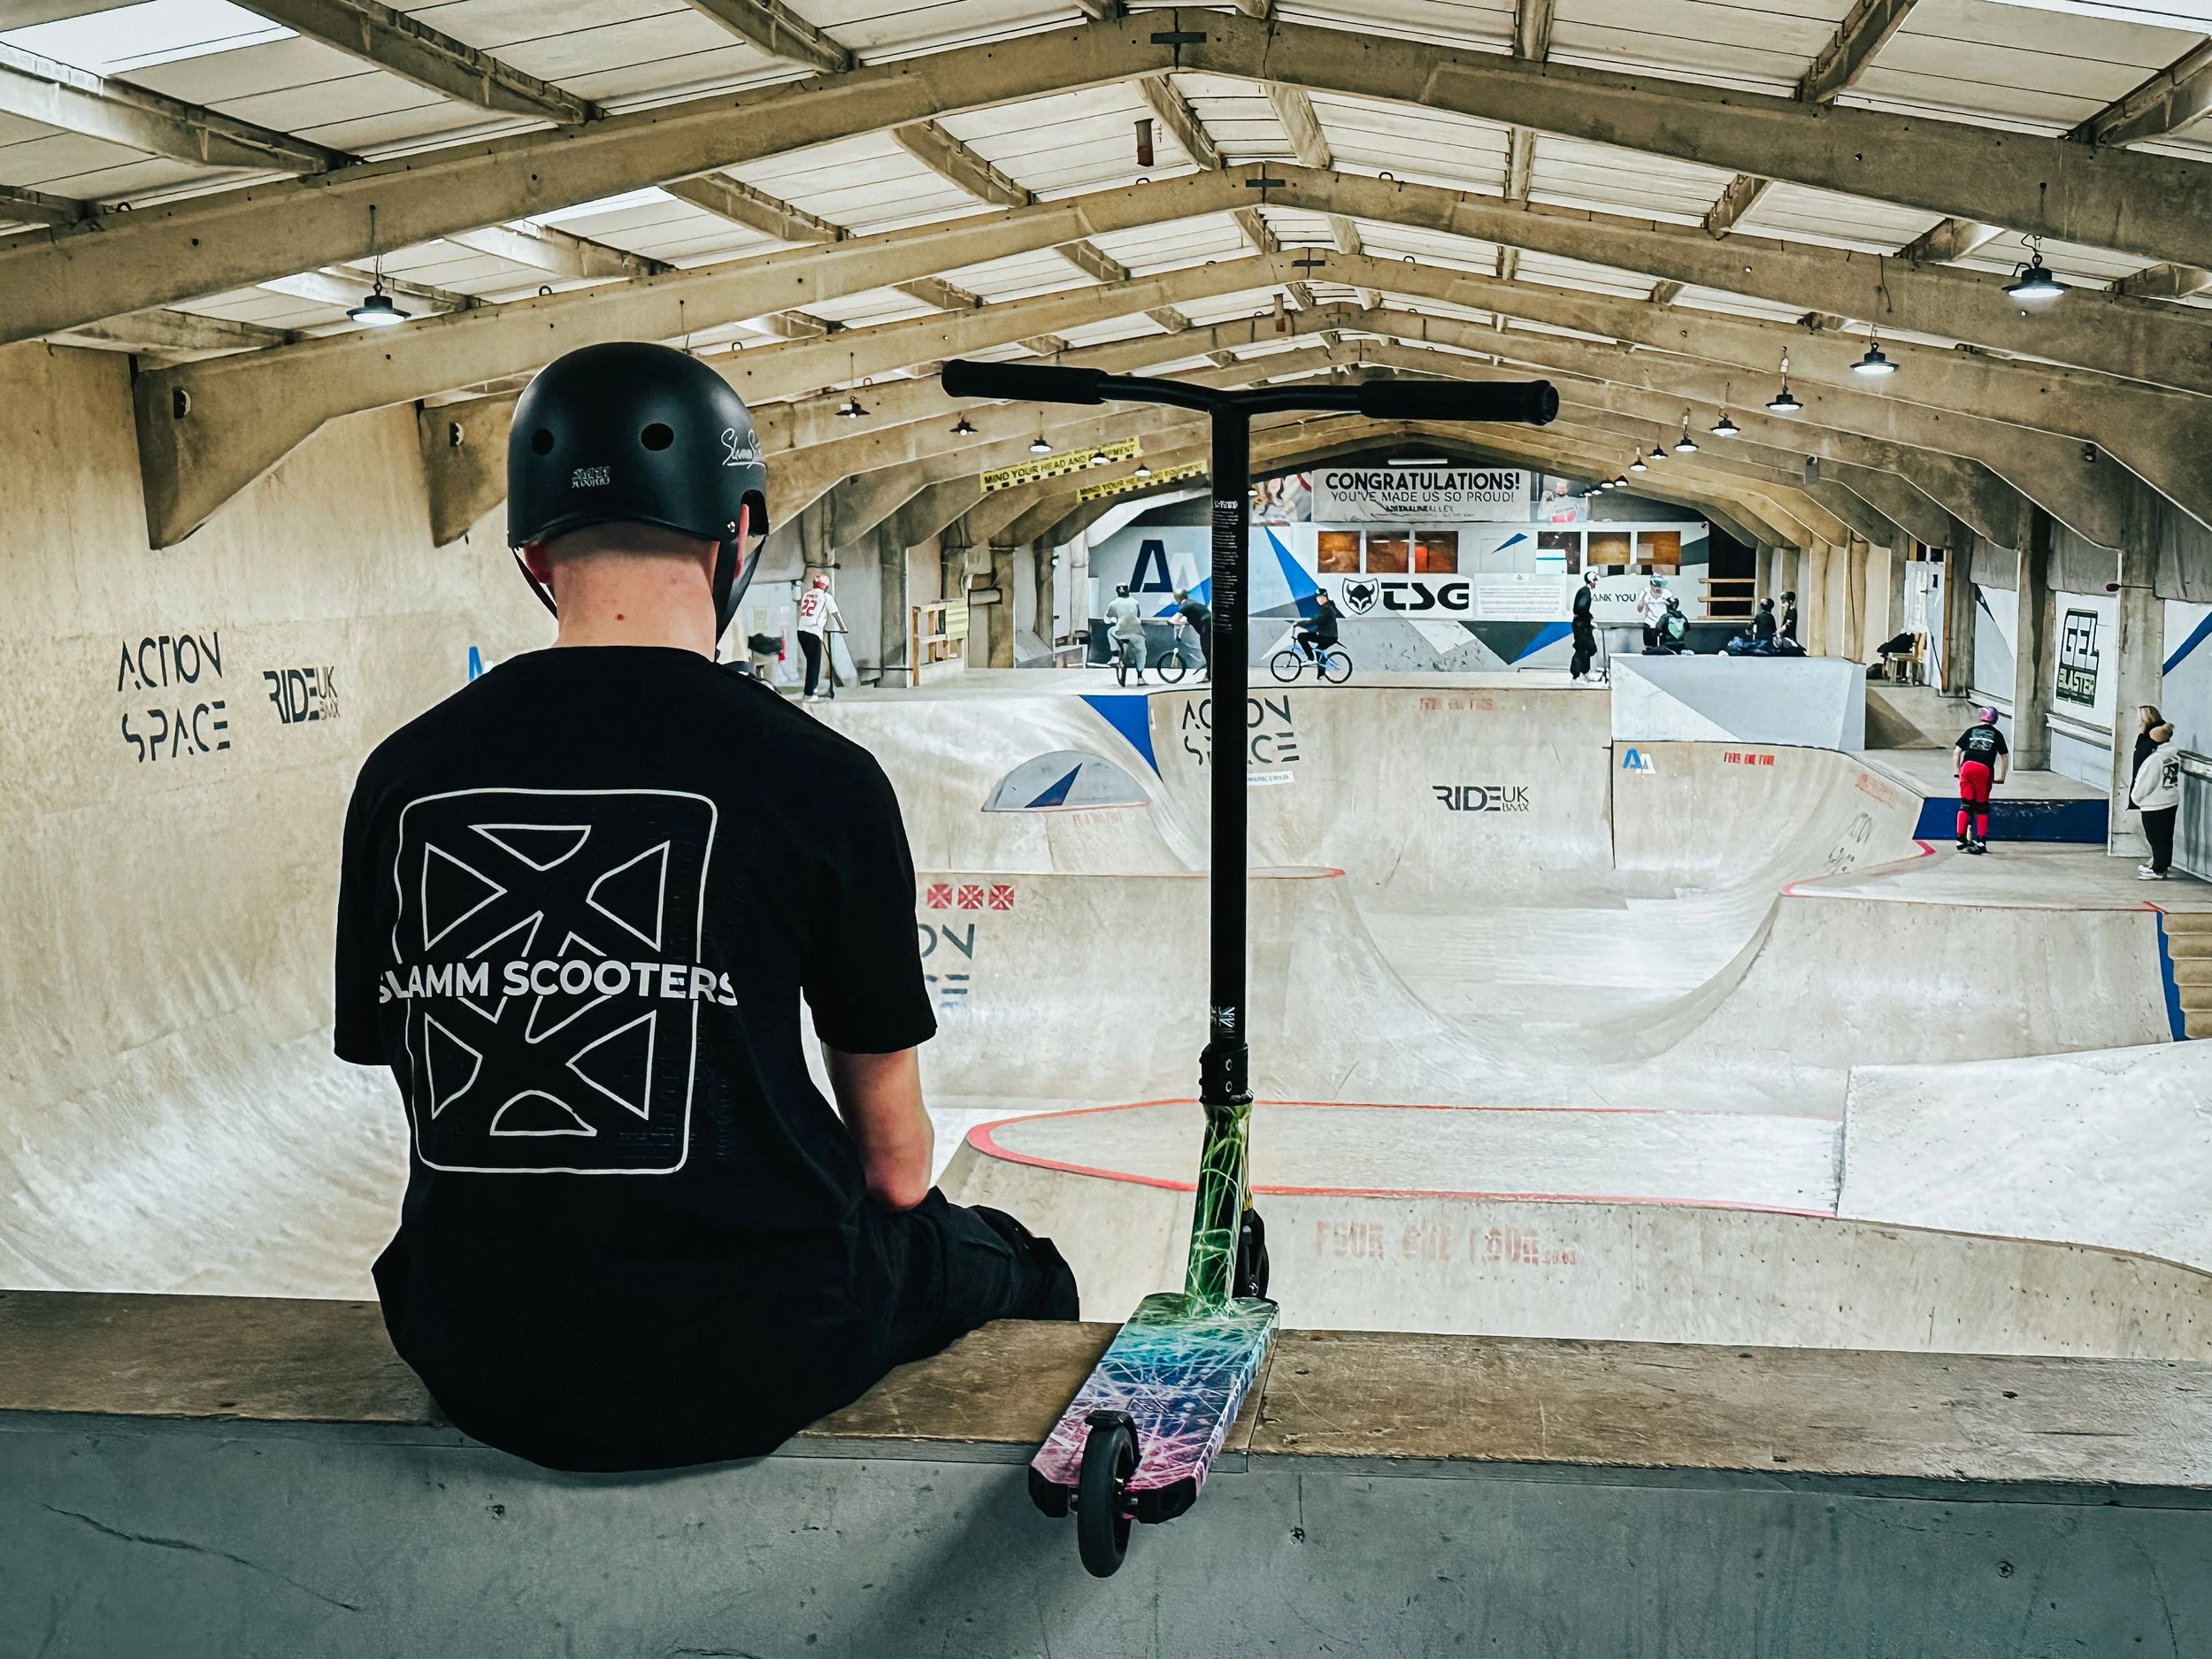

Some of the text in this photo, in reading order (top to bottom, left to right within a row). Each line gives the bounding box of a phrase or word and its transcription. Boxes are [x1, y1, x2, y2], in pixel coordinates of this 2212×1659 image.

[984, 472, 1010, 485] MIND
[1011, 465, 1038, 479] YOUR
[1041, 458, 1065, 471] HEAD
[1068, 455, 1087, 466] AND
[1325, 472, 1520, 490] CONGRATULATIONS!
[1332, 491, 1514, 503] YOU'VE MADE US SO PROUD!
[1381, 582, 1470, 611] TSG
[1592, 593, 1636, 602] ANK YOU
[118, 632, 223, 692] ACTION
[263, 667, 319, 724] RIDE
[1182, 695, 1292, 729] ACON
[122, 701, 230, 762] SPACE
[1184, 733, 1300, 765] SCE
[1432, 786, 1529, 811] RIDE UK
[503, 960, 738, 1006] SCOOTERS
